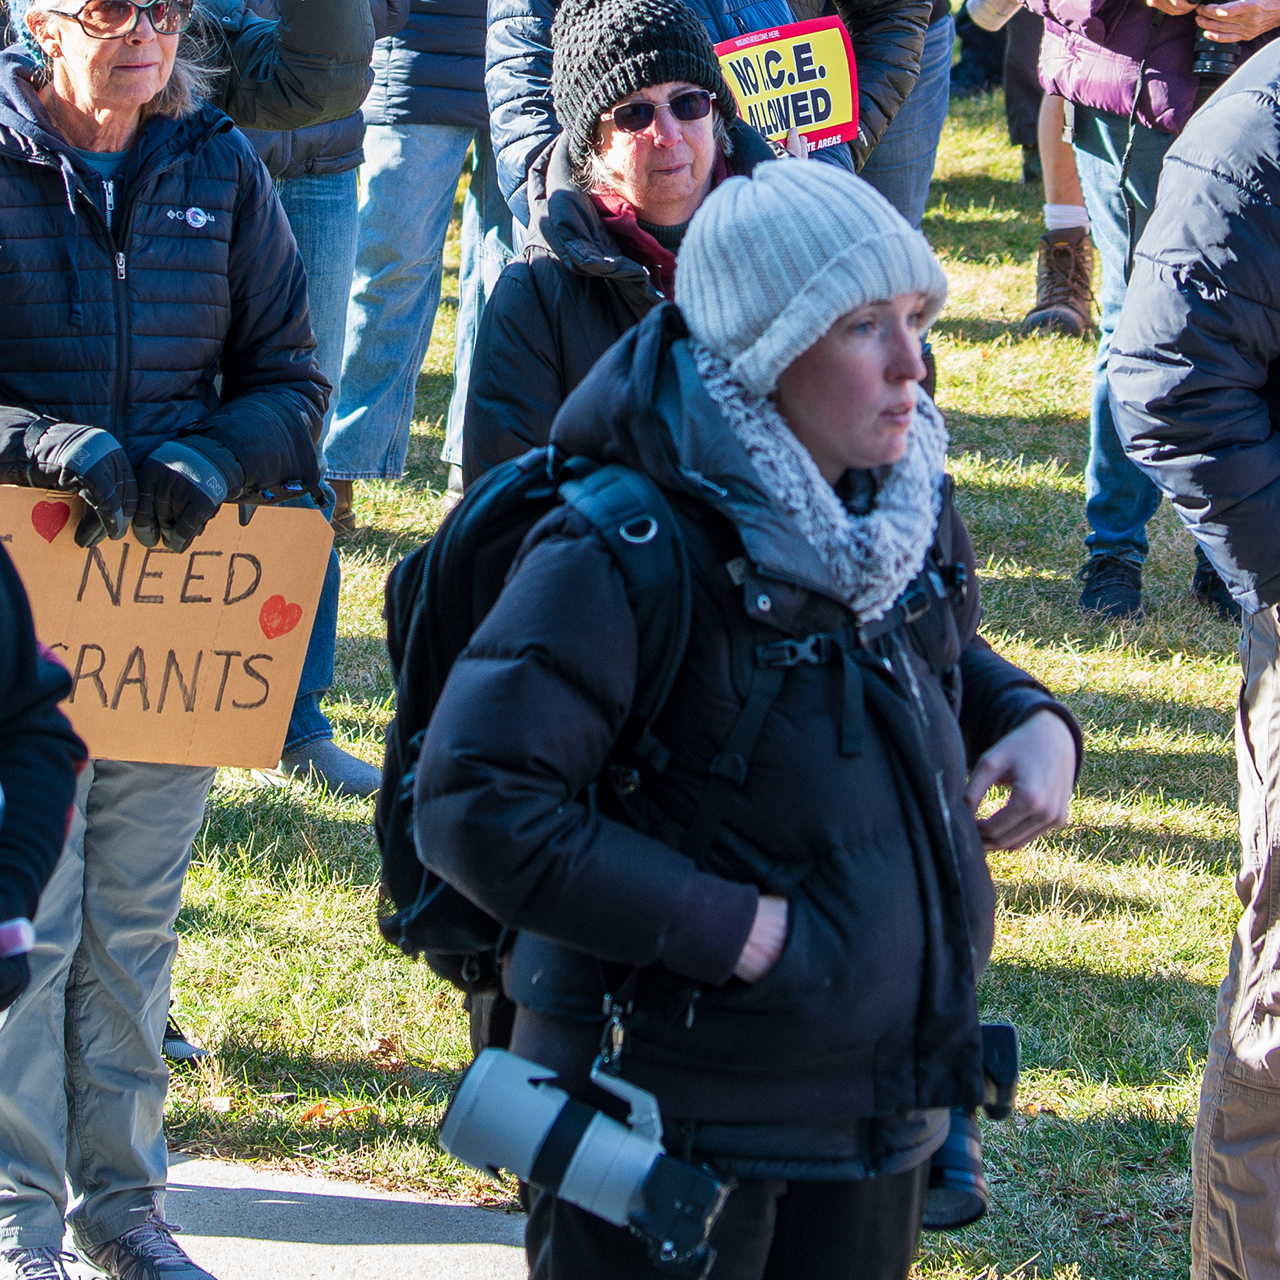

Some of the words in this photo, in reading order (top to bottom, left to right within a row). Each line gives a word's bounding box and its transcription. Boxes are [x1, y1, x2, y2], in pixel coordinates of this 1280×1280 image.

[728, 56, 759, 97] NO
[747, 87, 832, 136] ALLOWED
[817, 134, 842, 151] AREAS
[76, 542, 262, 607] NEED
[48, 642, 274, 714] RANTS
